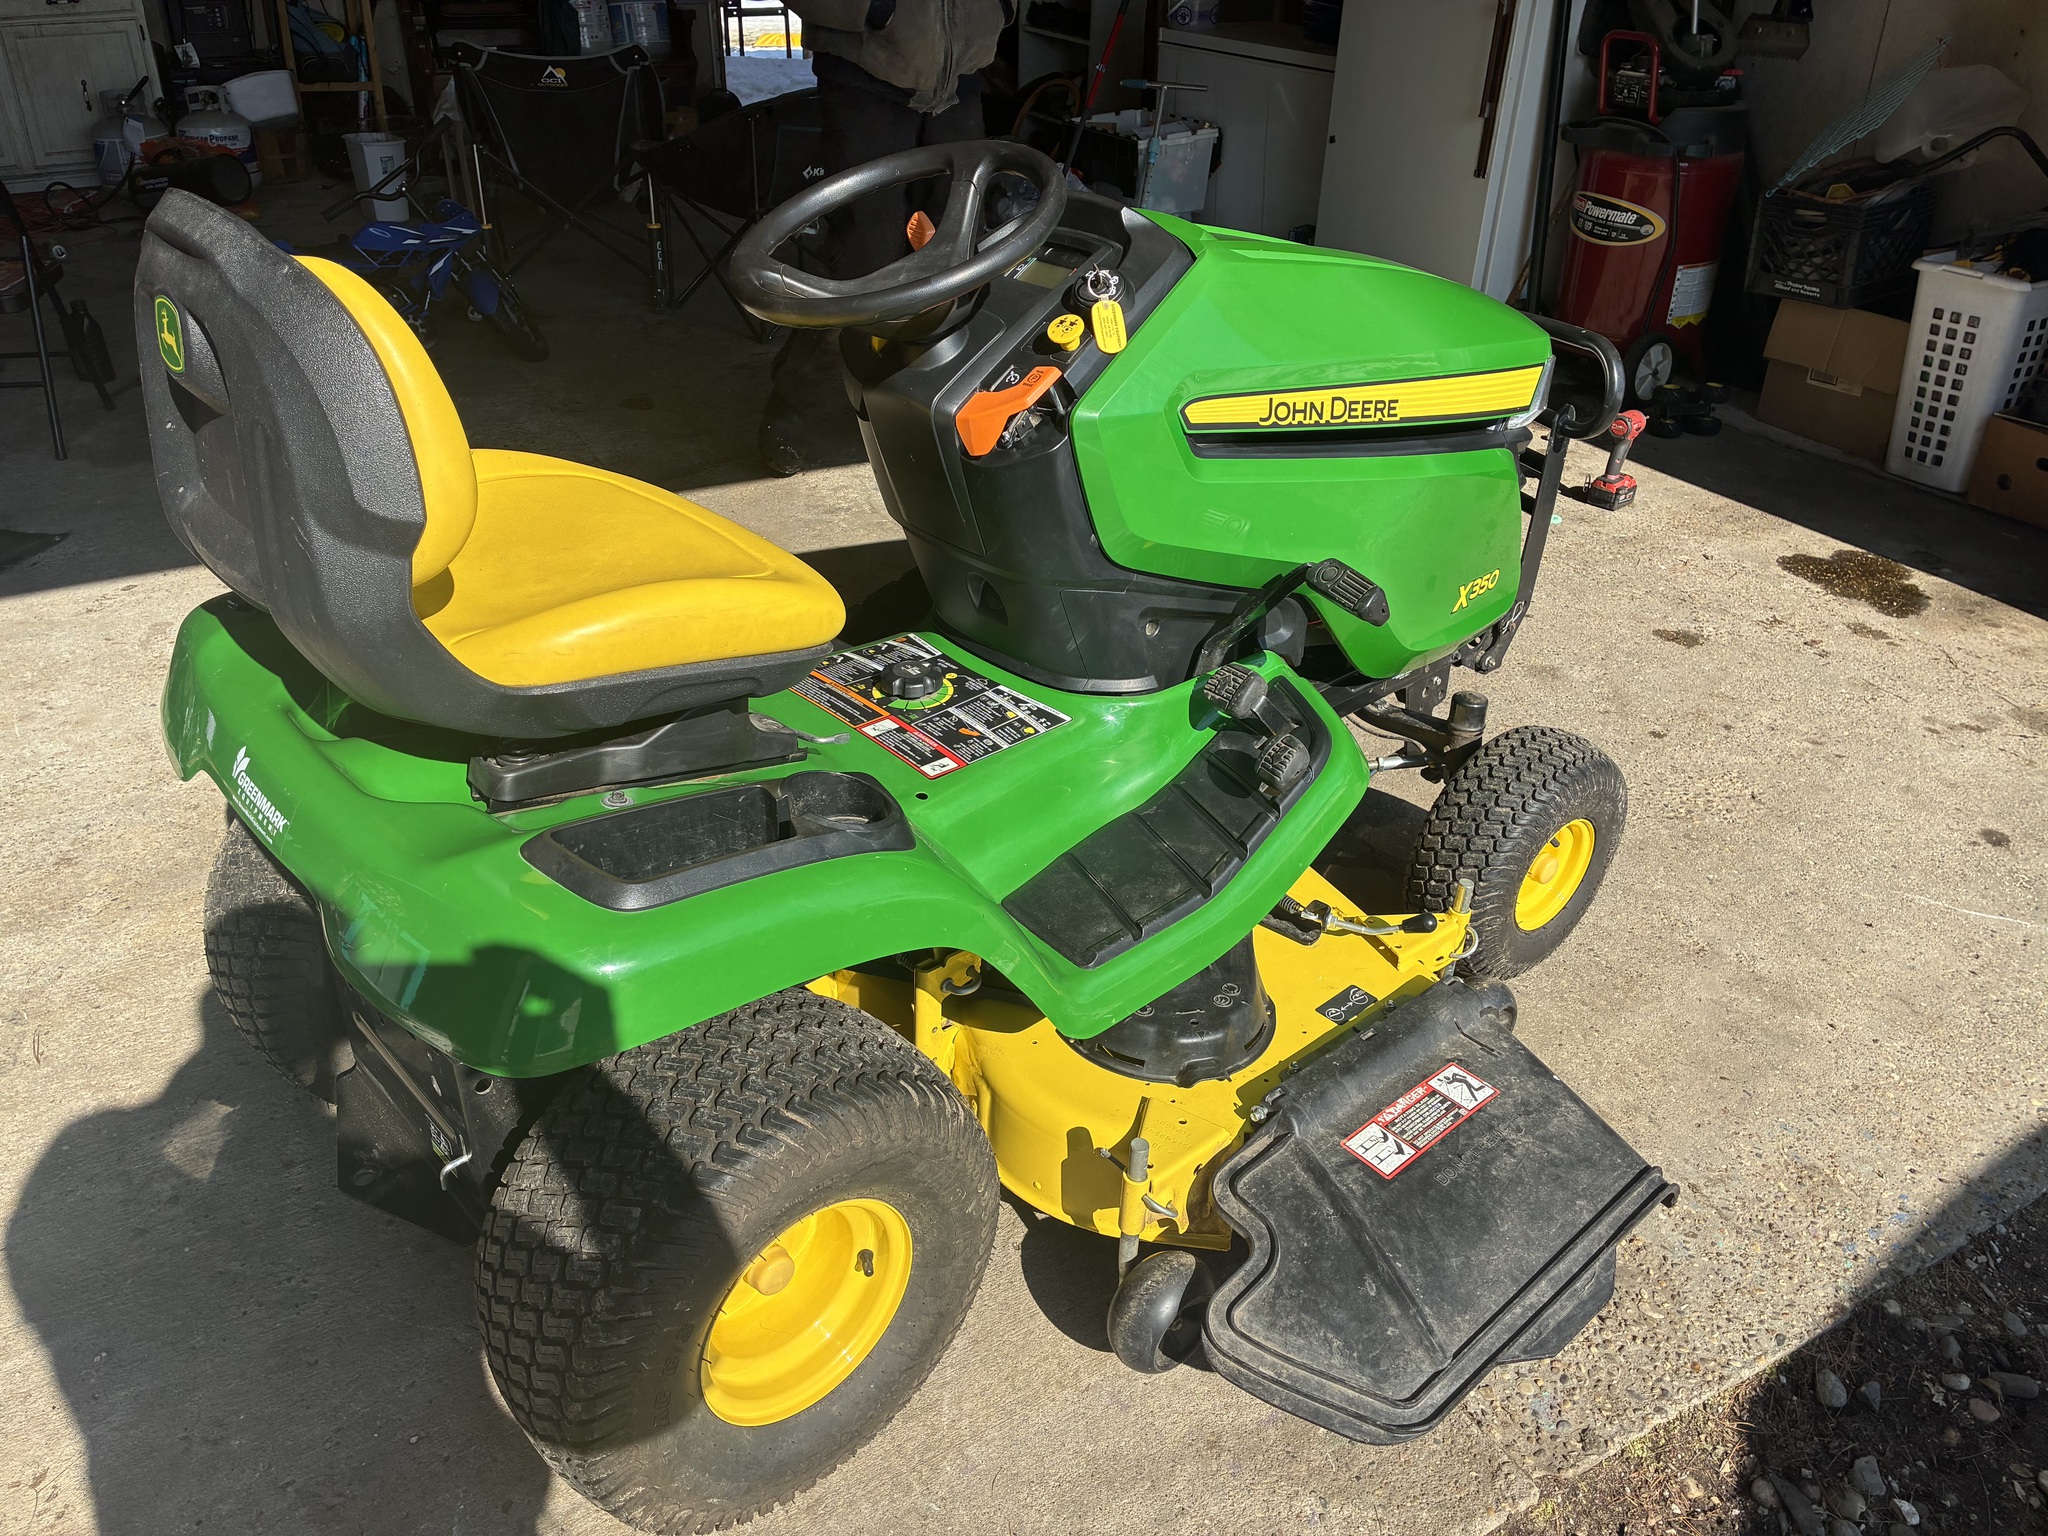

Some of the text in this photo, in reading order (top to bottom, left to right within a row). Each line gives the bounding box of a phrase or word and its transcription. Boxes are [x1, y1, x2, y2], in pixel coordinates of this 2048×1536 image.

[1583, 200, 1637, 225] Powermate
[1259, 396, 1399, 423] JOHN DEERE
[1451, 569, 1500, 614] X350
[237, 771, 287, 833] GREENMARK
[237, 788, 277, 836] EQUIPMENT
[1389, 1085, 1428, 1117] DANGER
[1434, 1167, 1458, 1186] DO
